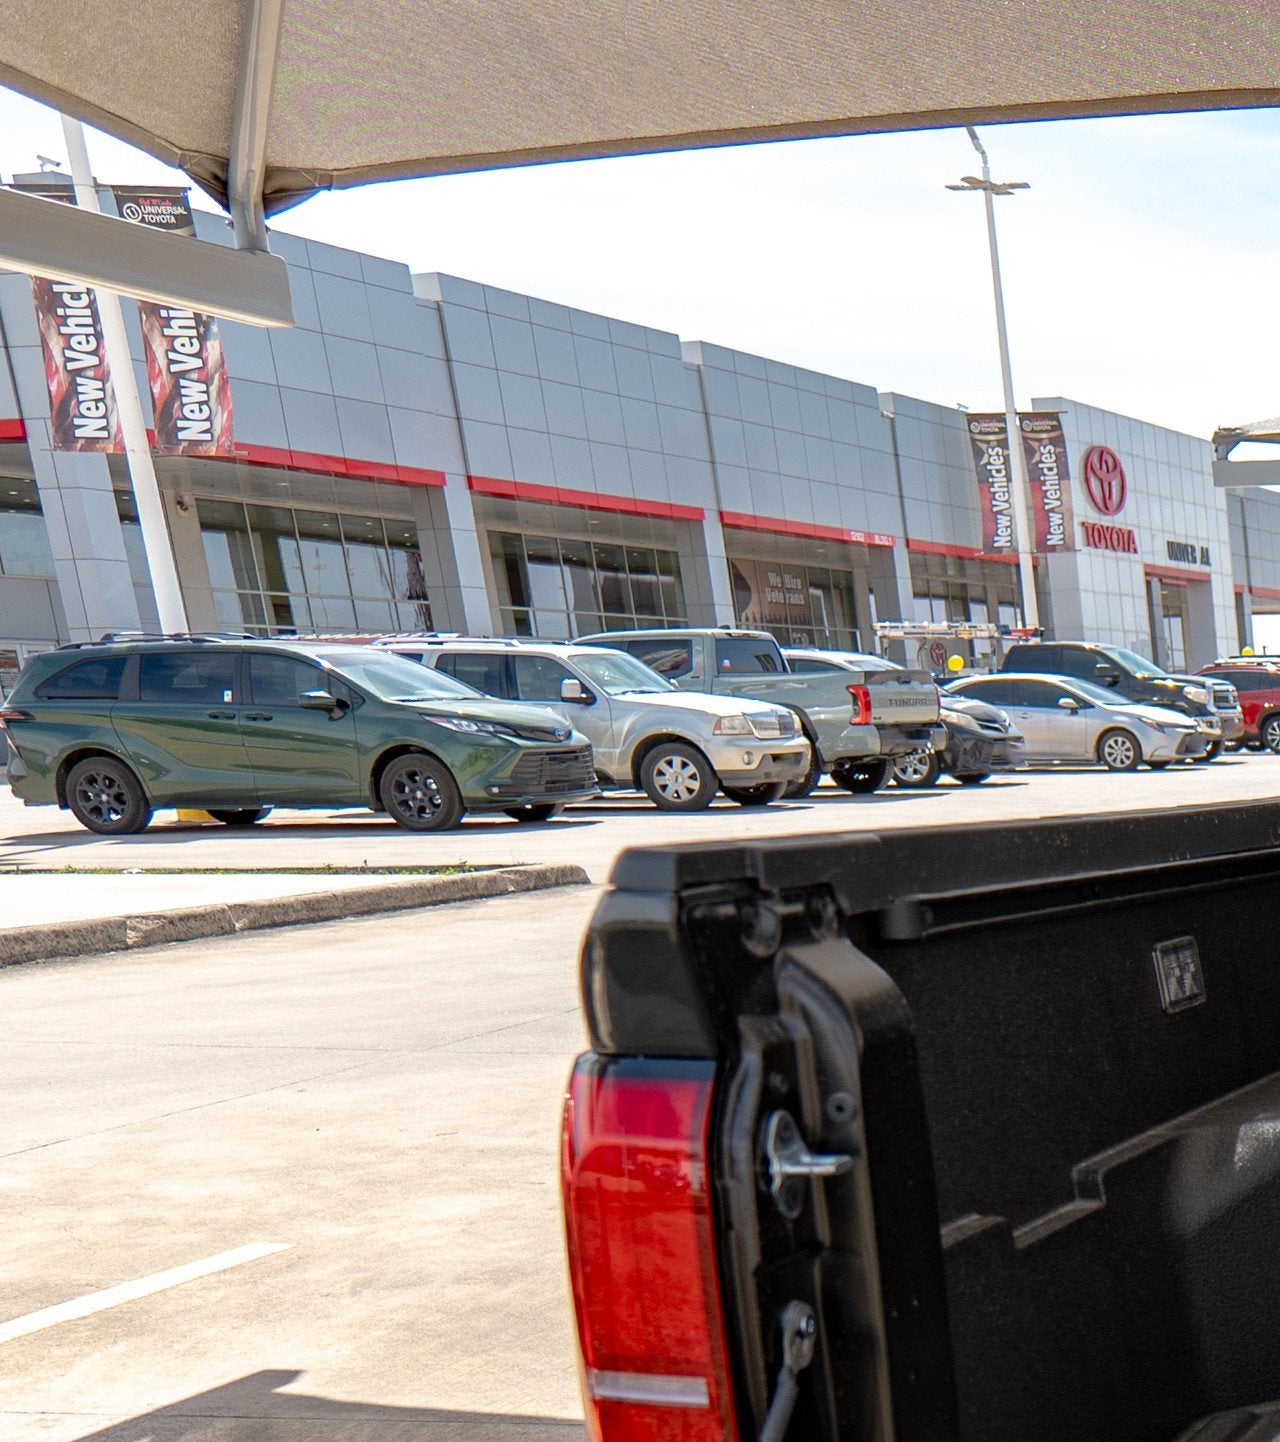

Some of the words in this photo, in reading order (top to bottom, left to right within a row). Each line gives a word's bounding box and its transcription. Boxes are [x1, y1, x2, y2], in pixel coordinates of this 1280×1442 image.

[141, 205, 188, 215] UNIVERSAL
[143, 214, 177, 224] TOYOTA
[73, 376, 109, 439] New
[176, 378, 213, 442] New
[987, 446, 1010, 512] Vehicles
[1038, 445, 1061, 511] Vehicles
[993, 515, 1011, 547] New
[1046, 512, 1065, 546] New
[1082, 521, 1139, 554] TOYOTA
[765, 587, 805, 606] Veterans
[767, 572, 782, 587] We
[784, 573, 802, 589] Hire
